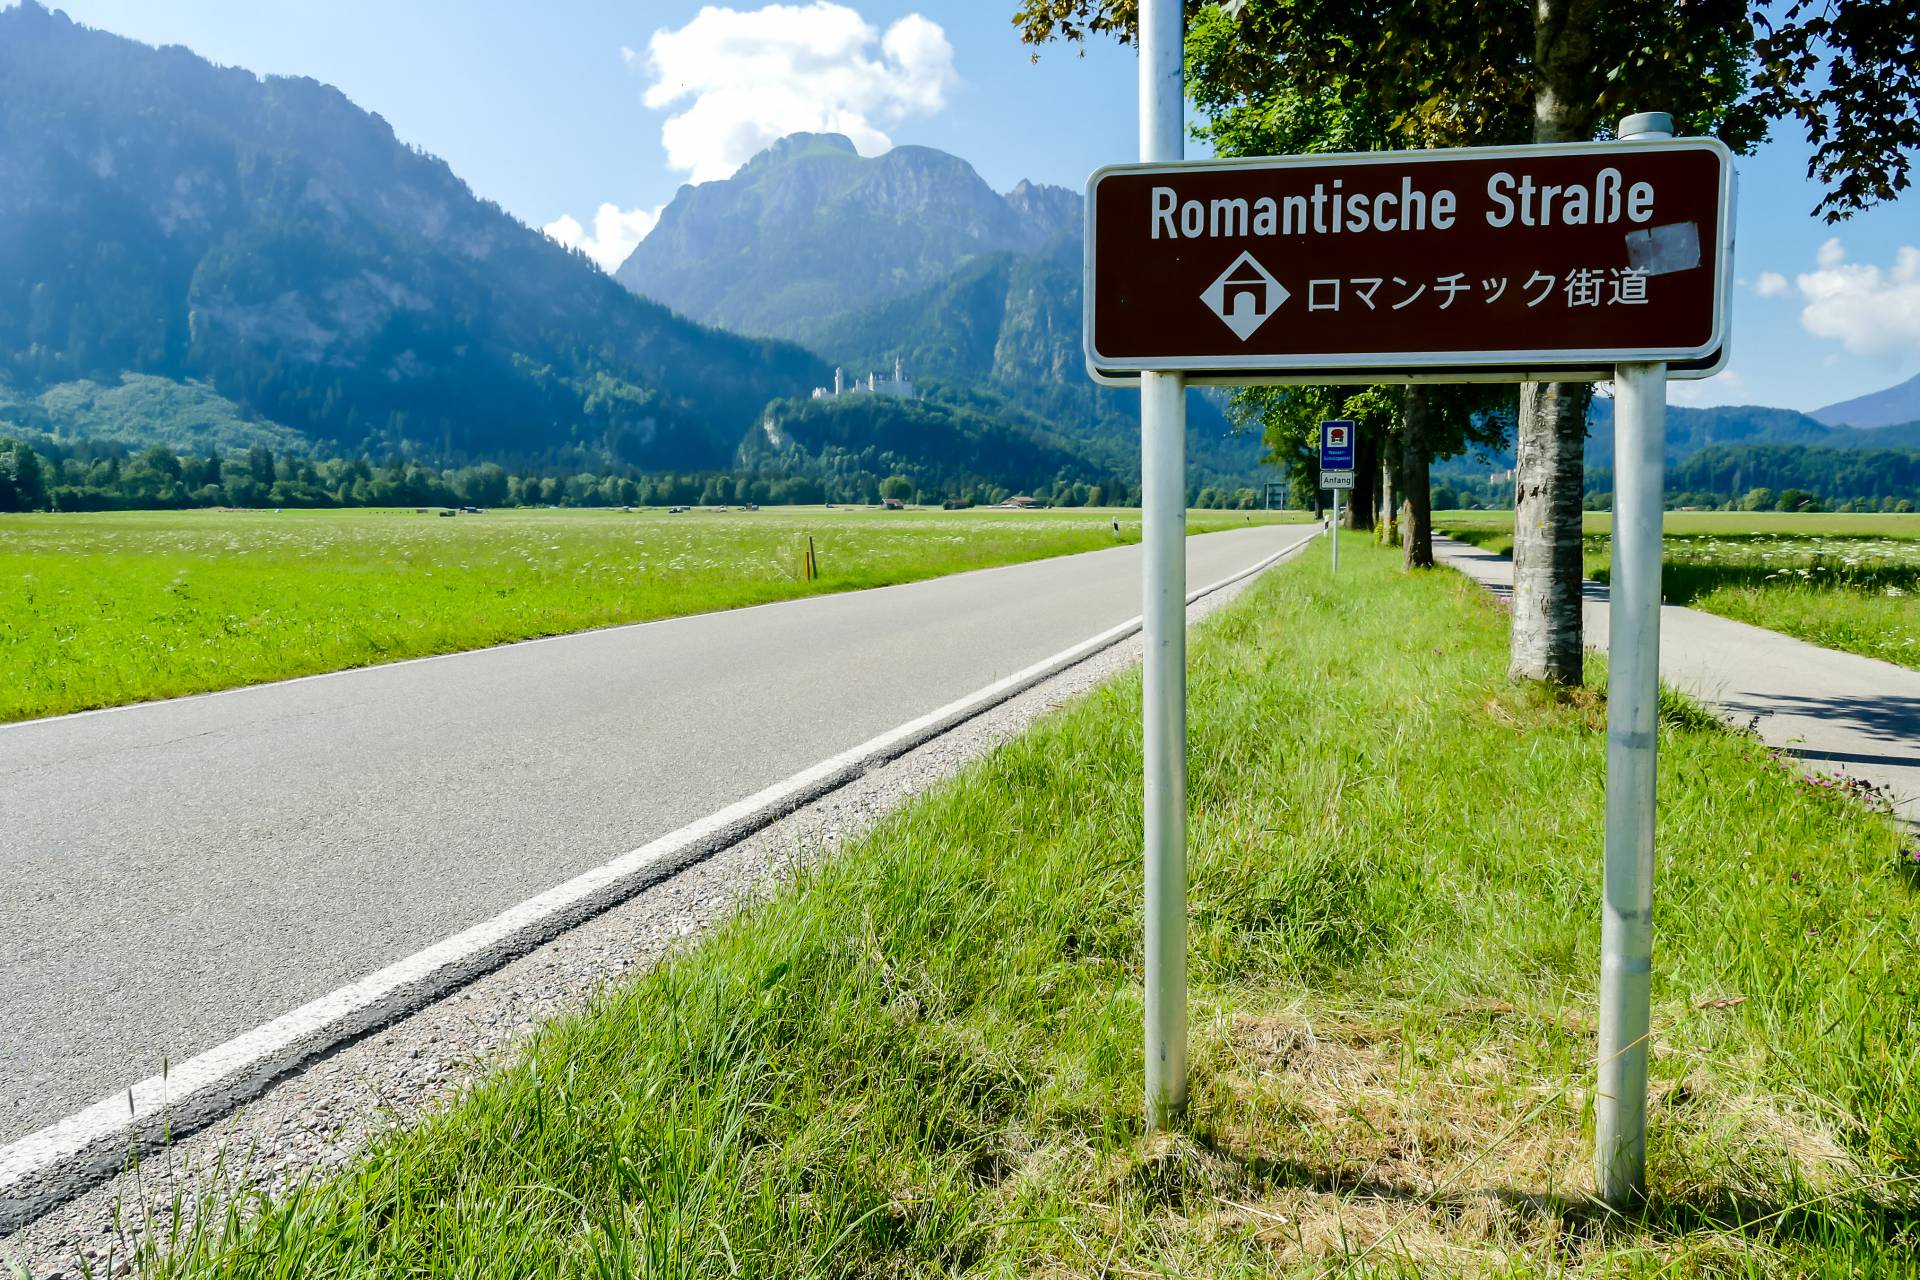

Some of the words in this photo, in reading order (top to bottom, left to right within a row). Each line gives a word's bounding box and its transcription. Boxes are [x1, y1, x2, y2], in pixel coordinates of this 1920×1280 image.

[1151, 177, 1457, 240] Romantische
[1486, 167, 1655, 229] Straße
[1308, 265, 1651, 312] ロマンチック街道
[1323, 477, 1351, 485] Anfang
